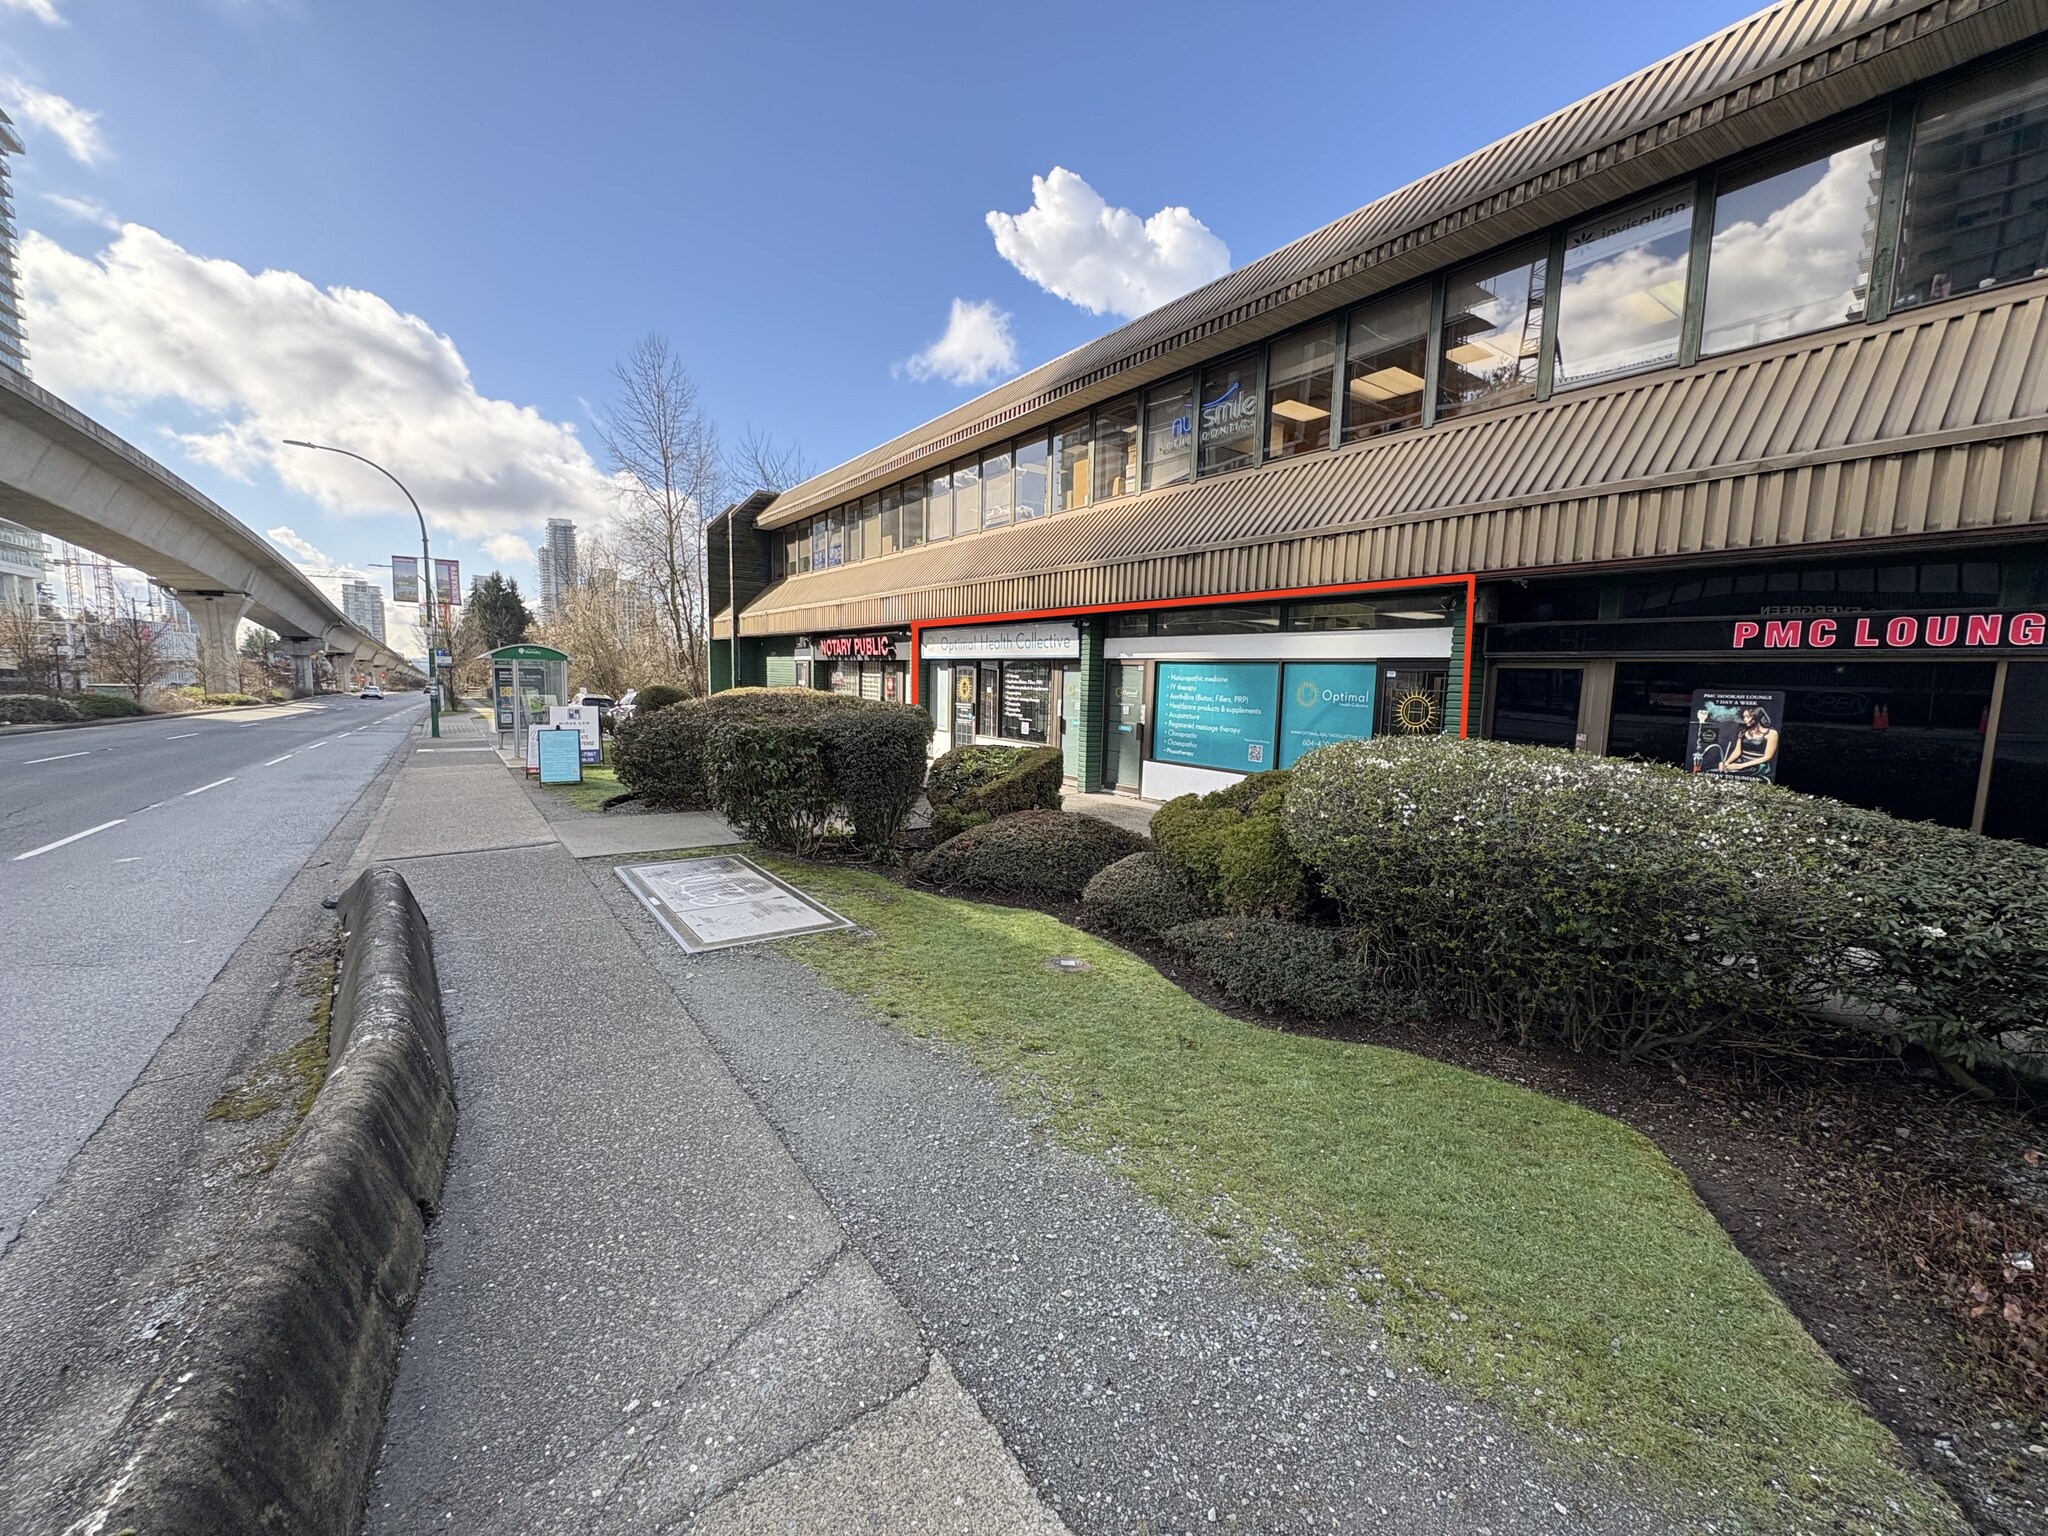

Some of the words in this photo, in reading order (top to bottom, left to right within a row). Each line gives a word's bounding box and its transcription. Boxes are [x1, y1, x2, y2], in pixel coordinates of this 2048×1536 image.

[1601, 202, 1686, 241] invisalign
[1203, 390, 1257, 428] smile
[451, 572, 460, 604] BURNABY
[1732, 618, 1837, 648] PMC
[820, 638, 852, 656] NOTARY
[854, 636, 889, 656] PUBLIC
[940, 634, 977, 653] Optimal
[980, 633, 1013, 650] Health
[1016, 631, 1071, 650] Collective
[1170, 674, 1204, 683] Naturopathic
[1204, 675, 1229, 683] medicine
[1177, 684, 1197, 692] therapy
[1234, 695, 1249, 704] PRP)
[1322, 689, 1369, 704] Optimal
[1802, 696, 1869, 711] OPEN
[1168, 711, 1200, 720] Acupuncture
[1169, 702, 1197, 710] Healthcare
[1197, 704, 1220, 712] products
[1226, 706, 1262, 715] supplements
[1167, 729, 1198, 739] Chiropractic
[1168, 720, 1195, 729] Registered
[1195, 724, 1219, 733] massage
[1219, 724, 1241, 735] therapy
[1167, 738, 1198, 749] Osteopathic
